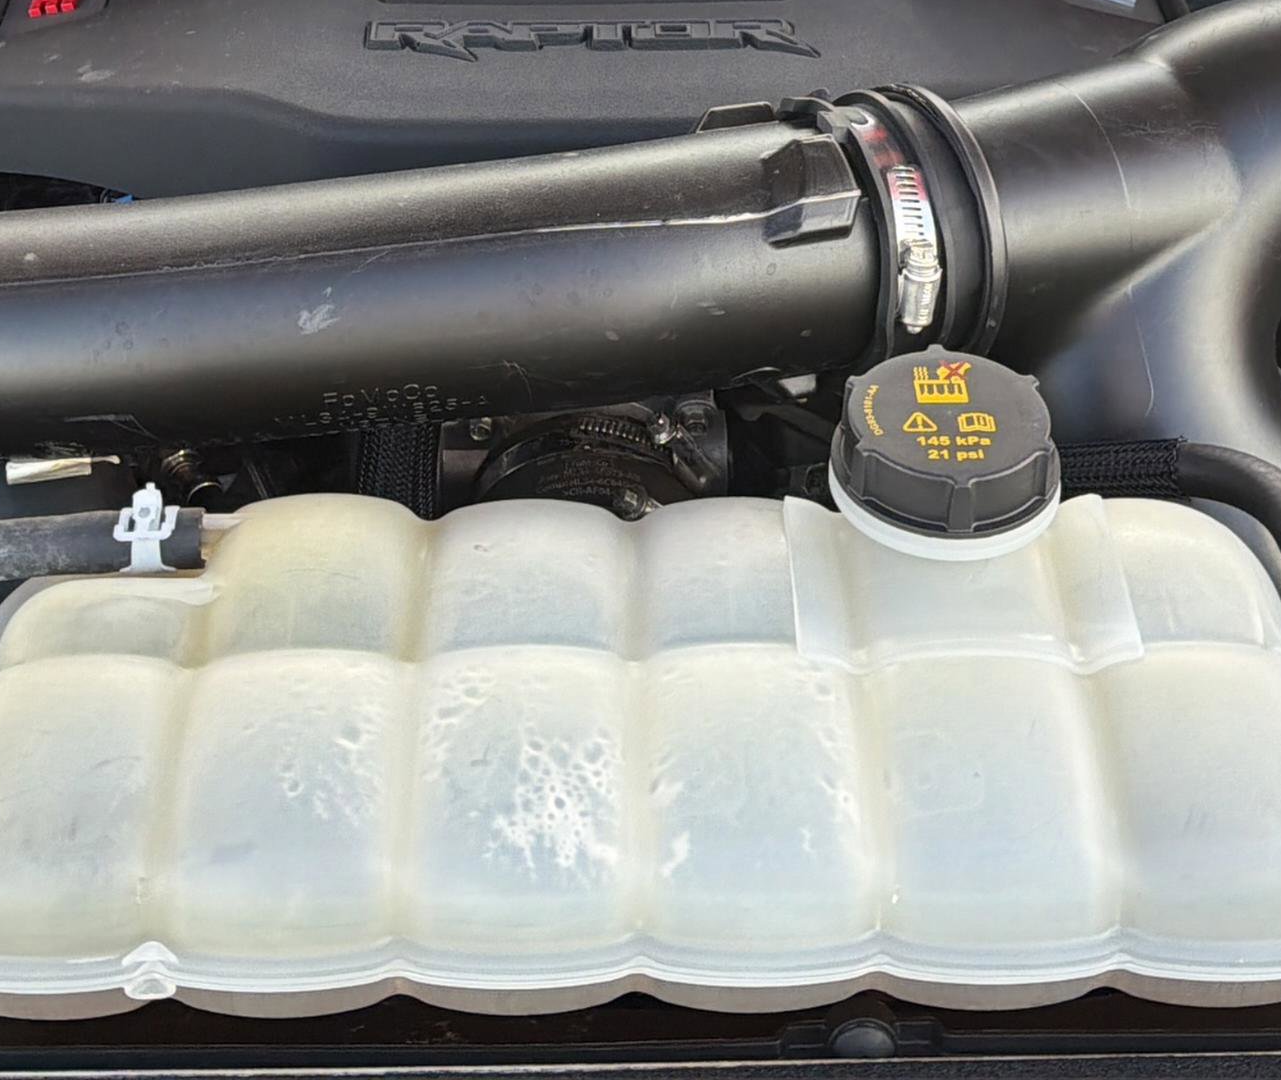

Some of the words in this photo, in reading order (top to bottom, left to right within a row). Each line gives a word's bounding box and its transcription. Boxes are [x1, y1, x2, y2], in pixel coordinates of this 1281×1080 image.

[364, 19, 821, 63] RAPTOR
[917, 436, 951, 446] 145
[956, 436, 992, 446] kPa
[927, 449, 950, 460] 21
[957, 449, 985, 461] psi
